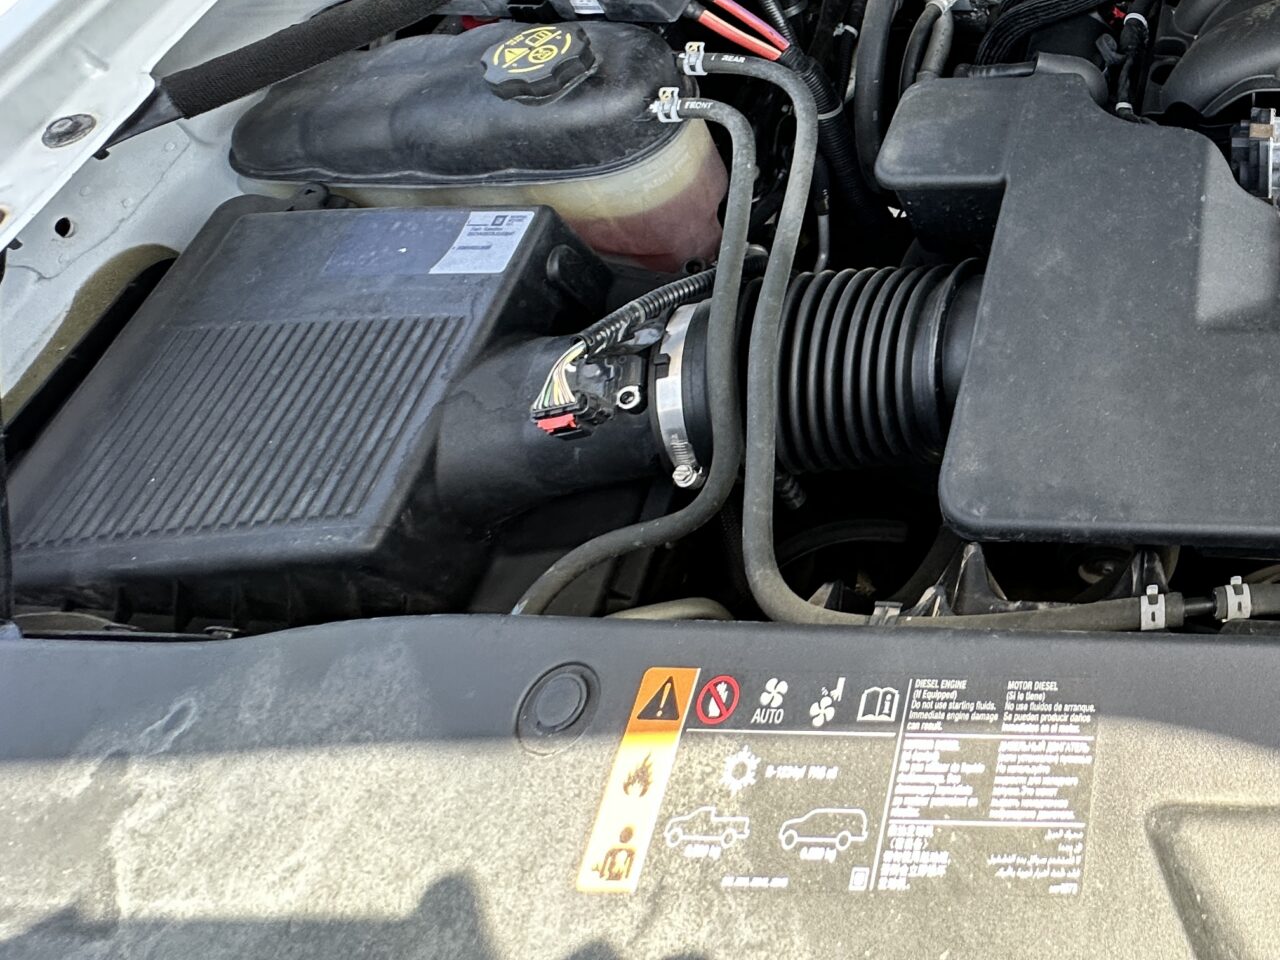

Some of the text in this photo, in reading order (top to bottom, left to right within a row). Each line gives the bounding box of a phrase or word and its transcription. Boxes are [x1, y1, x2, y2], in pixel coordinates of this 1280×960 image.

[684, 101, 714, 110] FRONT
[915, 679, 967, 689] DIESEL ENGINE
[1007, 681, 1058, 691] MOTOR DIESEL
[948, 701, 974, 711] starting
[750, 707, 784, 724] AUTO
[947, 712, 969, 722] engine
[971, 712, 998, 722] damage
